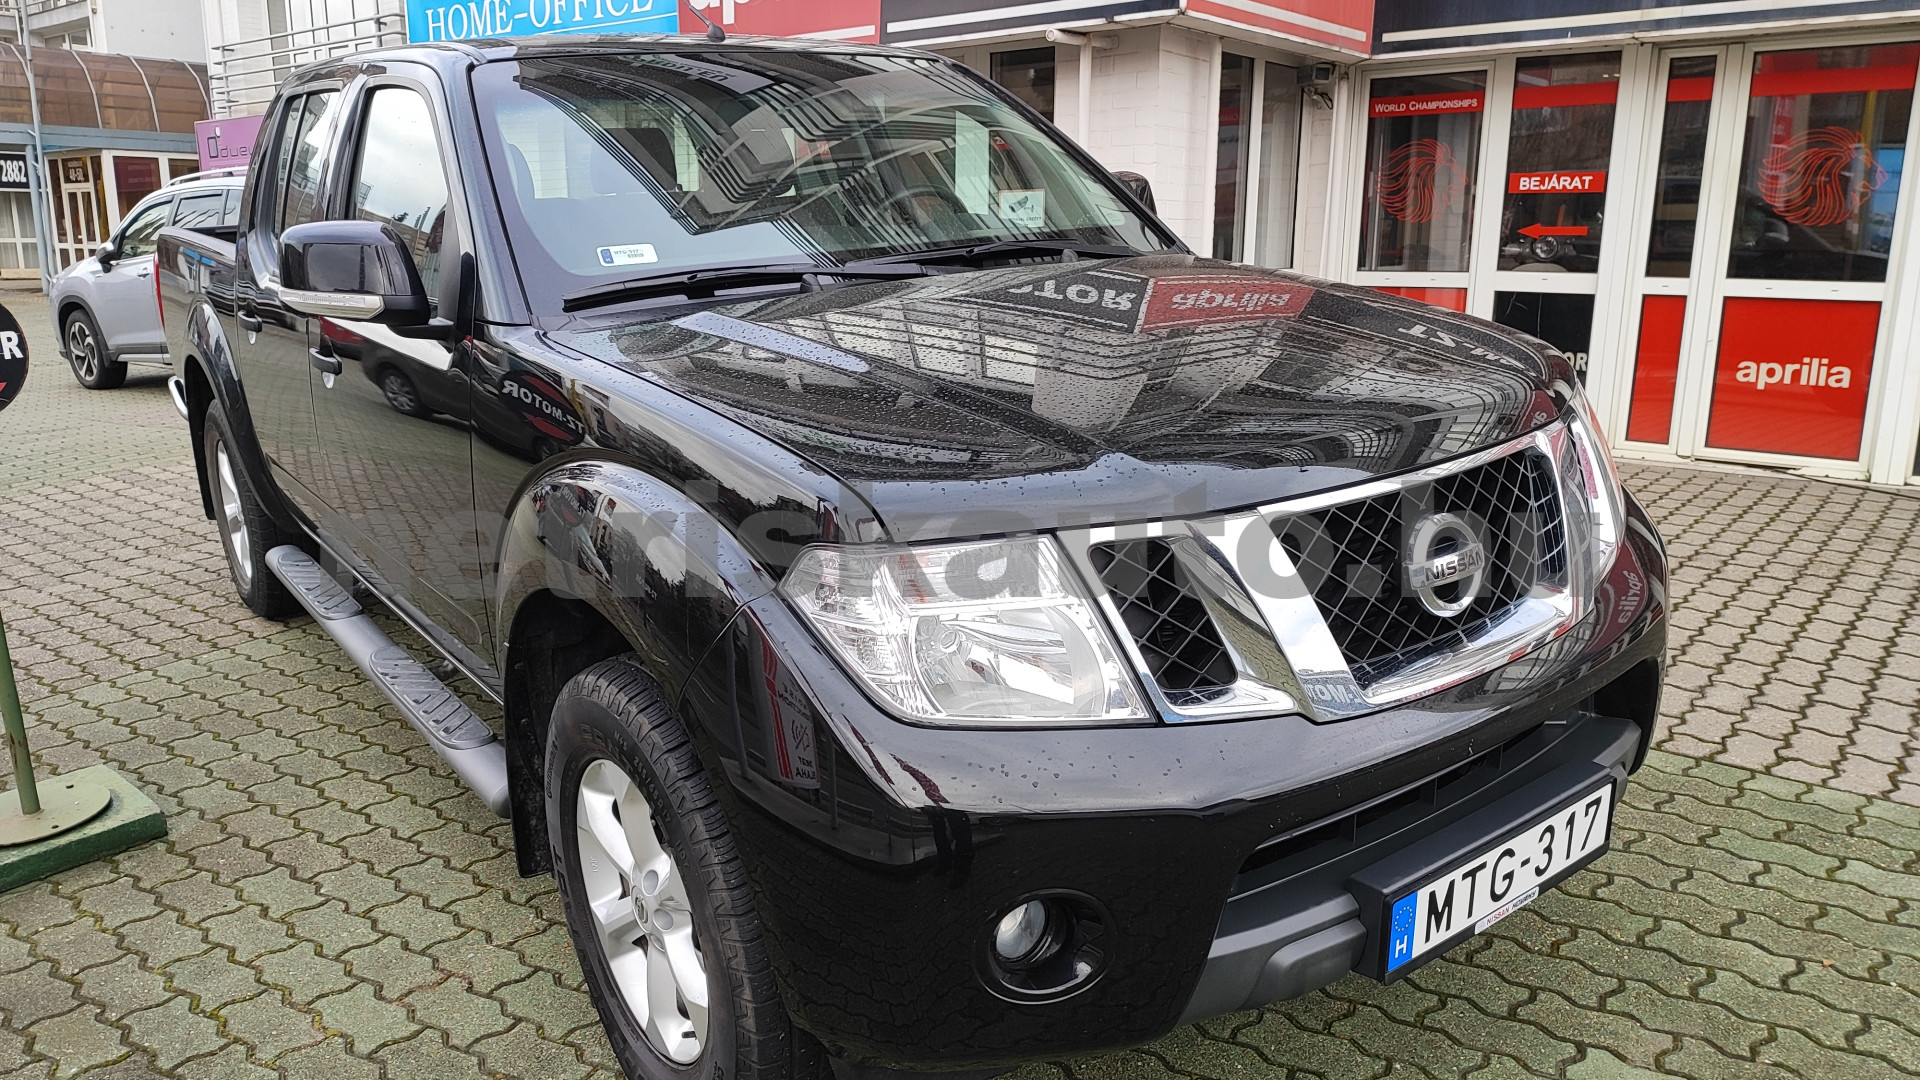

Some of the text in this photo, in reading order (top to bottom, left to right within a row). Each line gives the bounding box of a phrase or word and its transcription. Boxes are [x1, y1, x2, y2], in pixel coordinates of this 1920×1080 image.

[0, 160, 27, 183] 2882
[1519, 174, 1593, 190] BEJÁRAT
[1735, 357, 1851, 390] aprilia
[1424, 547, 1484, 583] NISSAN
[1424, 794, 1602, 944] MTG-317
[1486, 906, 1510, 925] NISSAN
[1395, 934, 1408, 959] H
